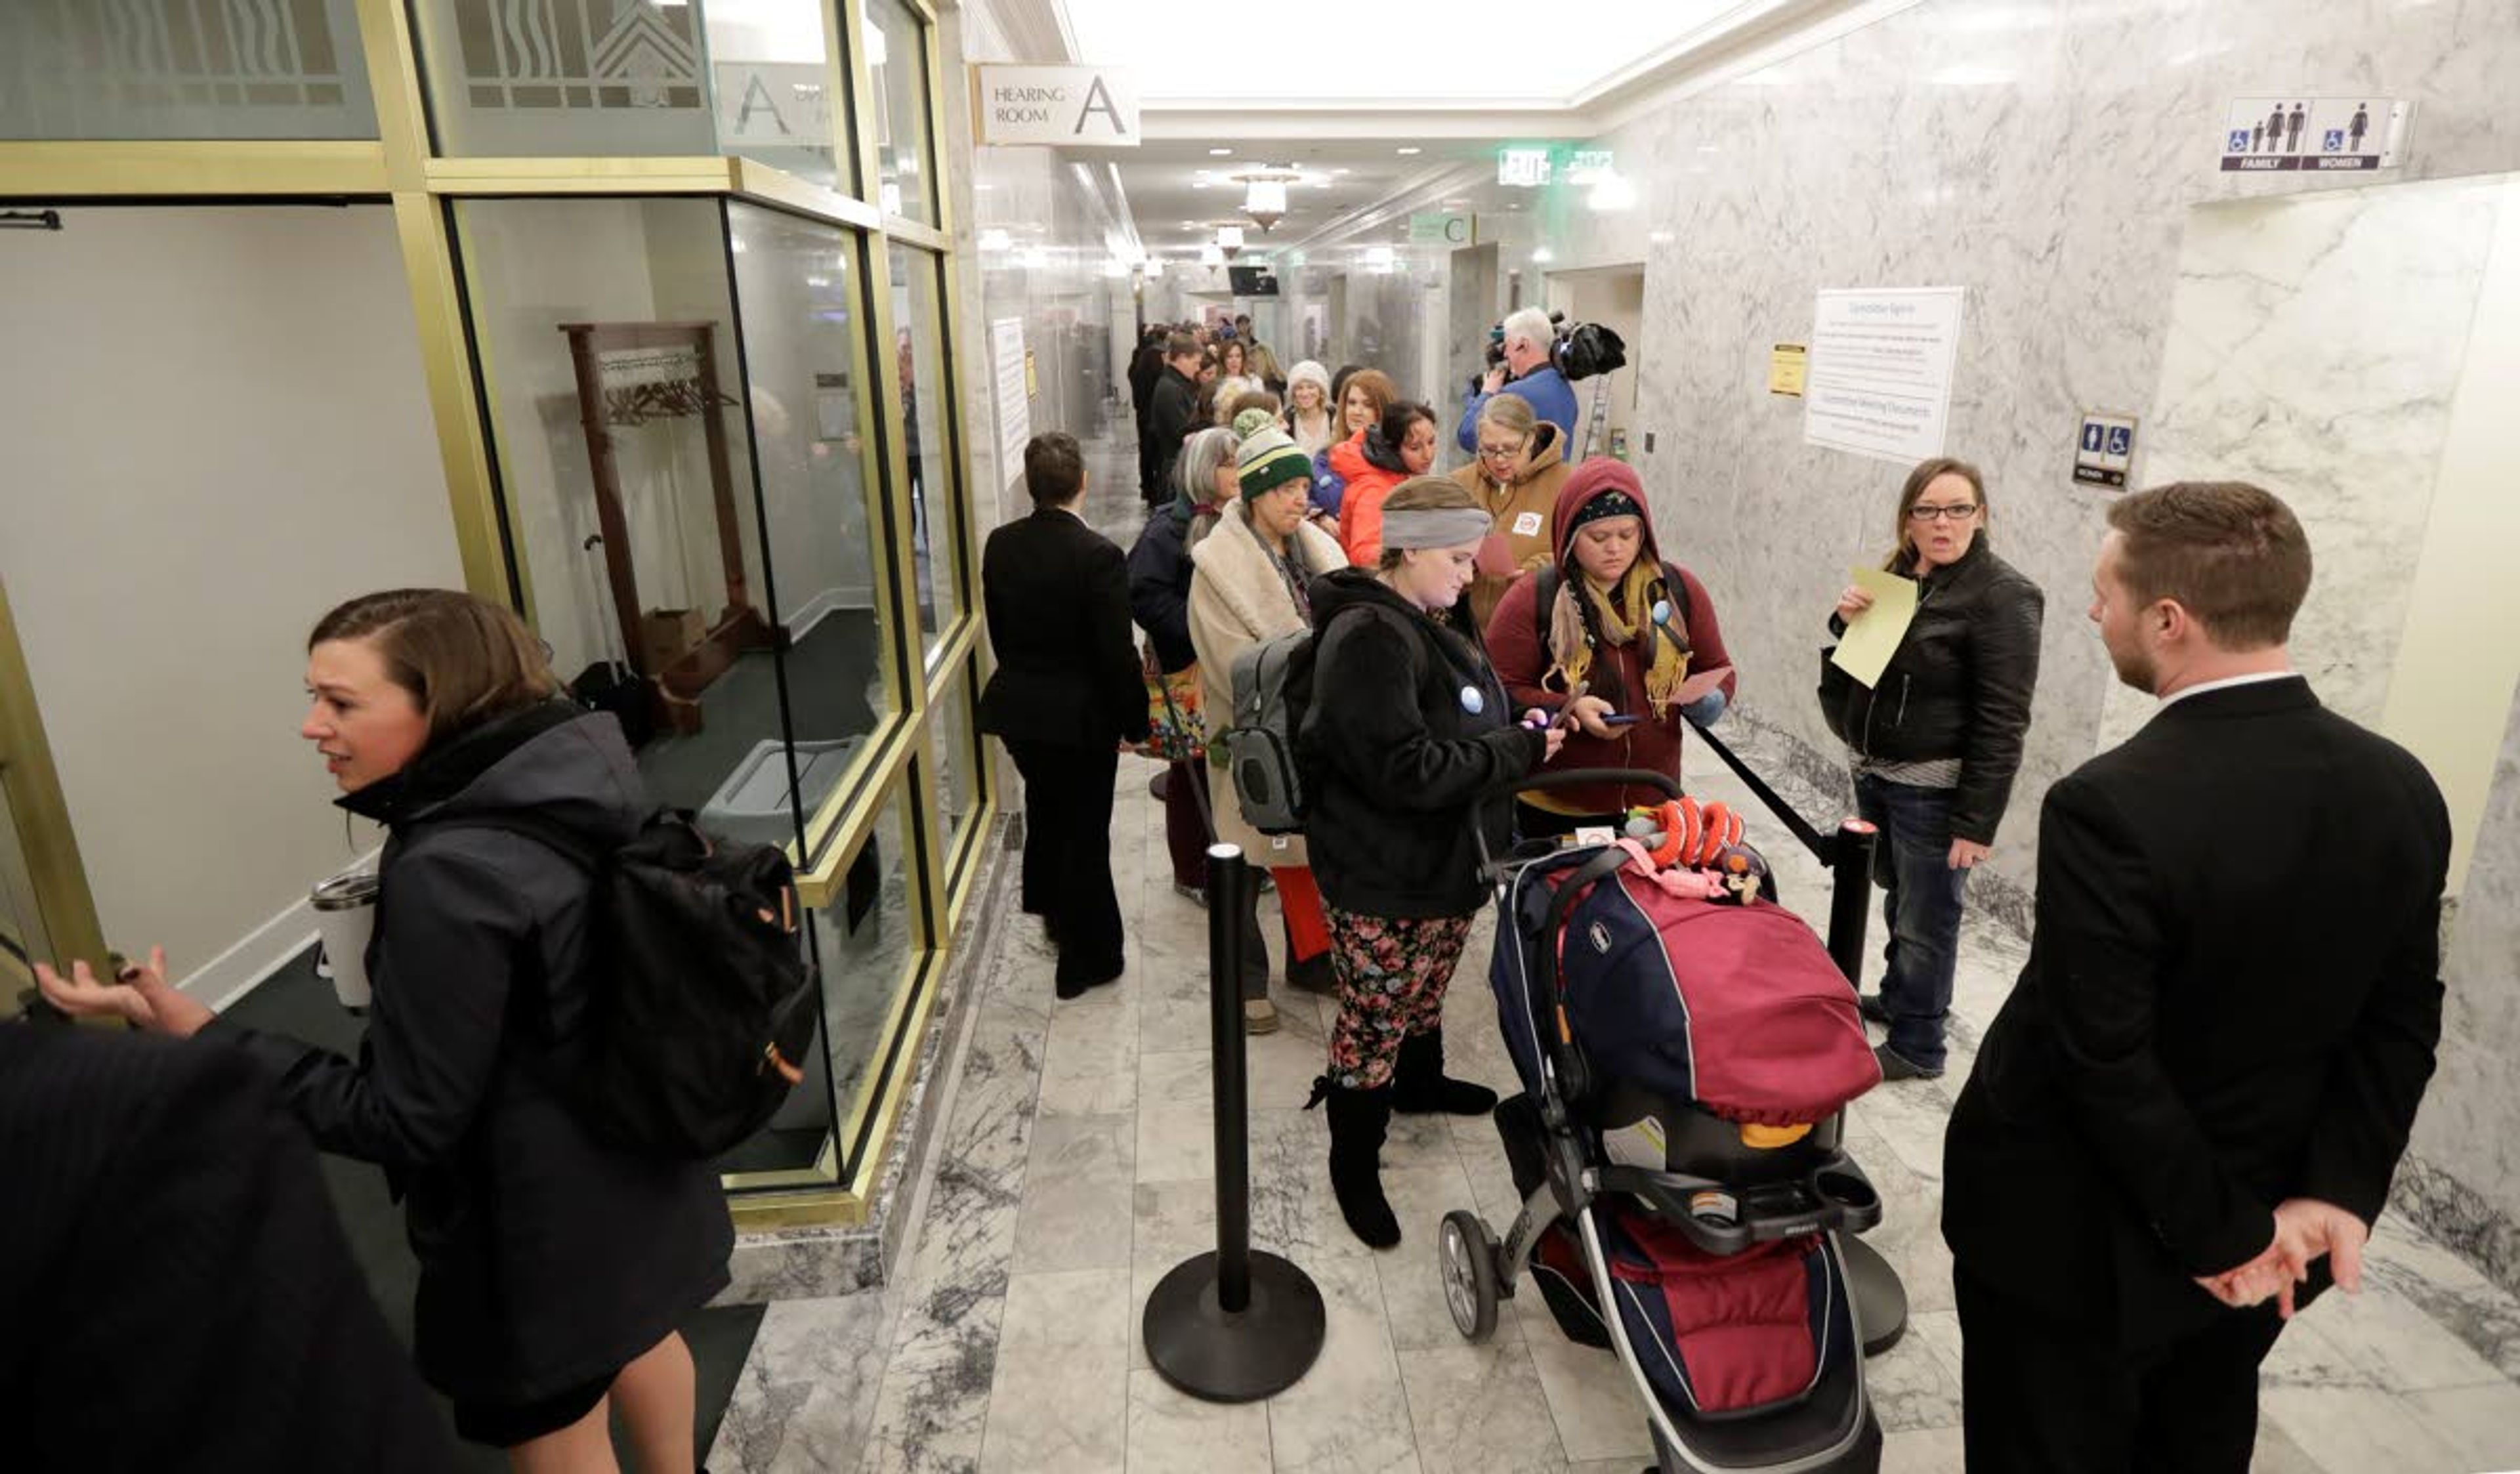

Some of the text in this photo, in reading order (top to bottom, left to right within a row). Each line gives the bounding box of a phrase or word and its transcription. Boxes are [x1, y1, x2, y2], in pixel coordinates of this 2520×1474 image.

[995, 88, 1065, 102] HEARING
[1074, 74, 1126, 133] A
[996, 108, 1049, 123] ROOM
[2240, 157, 2281, 169] FAMILY
[2319, 157, 2362, 169] WOMEN
[1445, 218, 1464, 242] C
